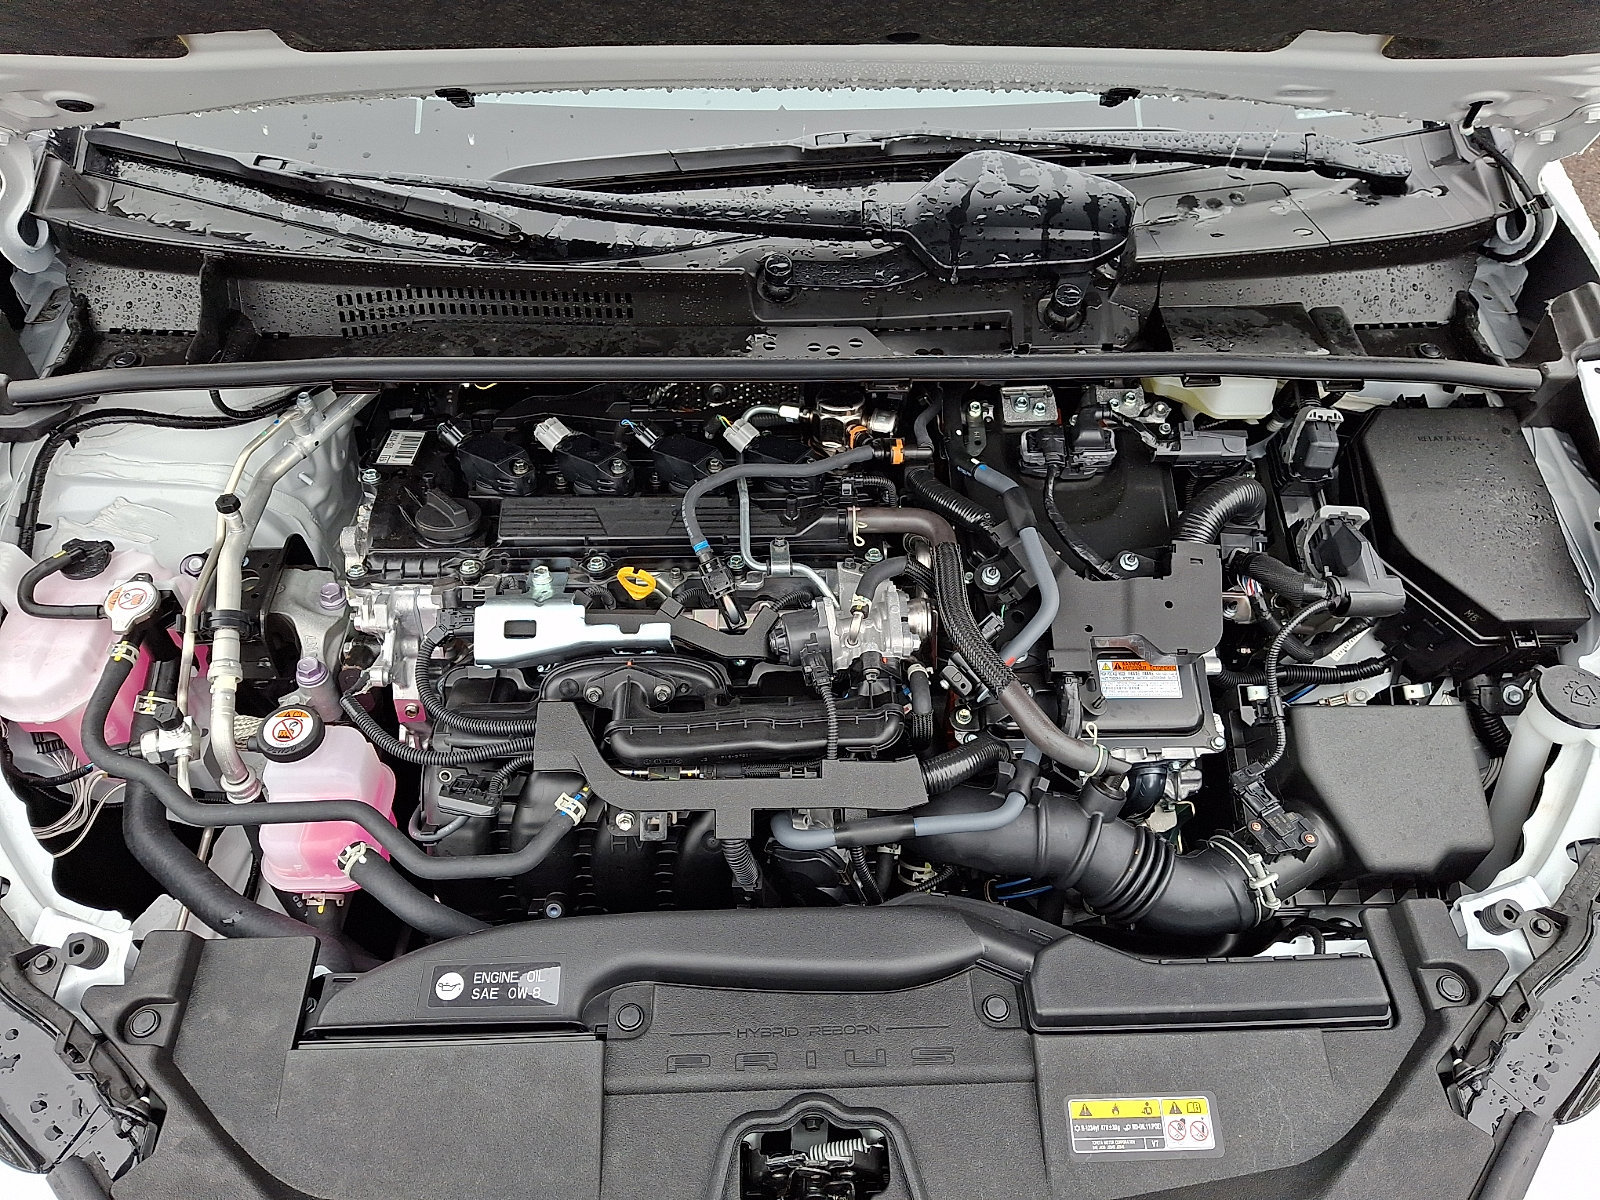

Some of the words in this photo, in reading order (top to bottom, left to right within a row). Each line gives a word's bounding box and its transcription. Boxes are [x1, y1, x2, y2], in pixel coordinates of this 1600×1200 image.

[473, 971, 519, 984] ENGINE
[527, 970, 545, 983] OIL
[471, 987, 500, 1000] SAE
[736, 1026, 799, 1039] HYBRID
[808, 1024, 880, 1037] REBORN
[666, 1047, 956, 1074] PRIUS
